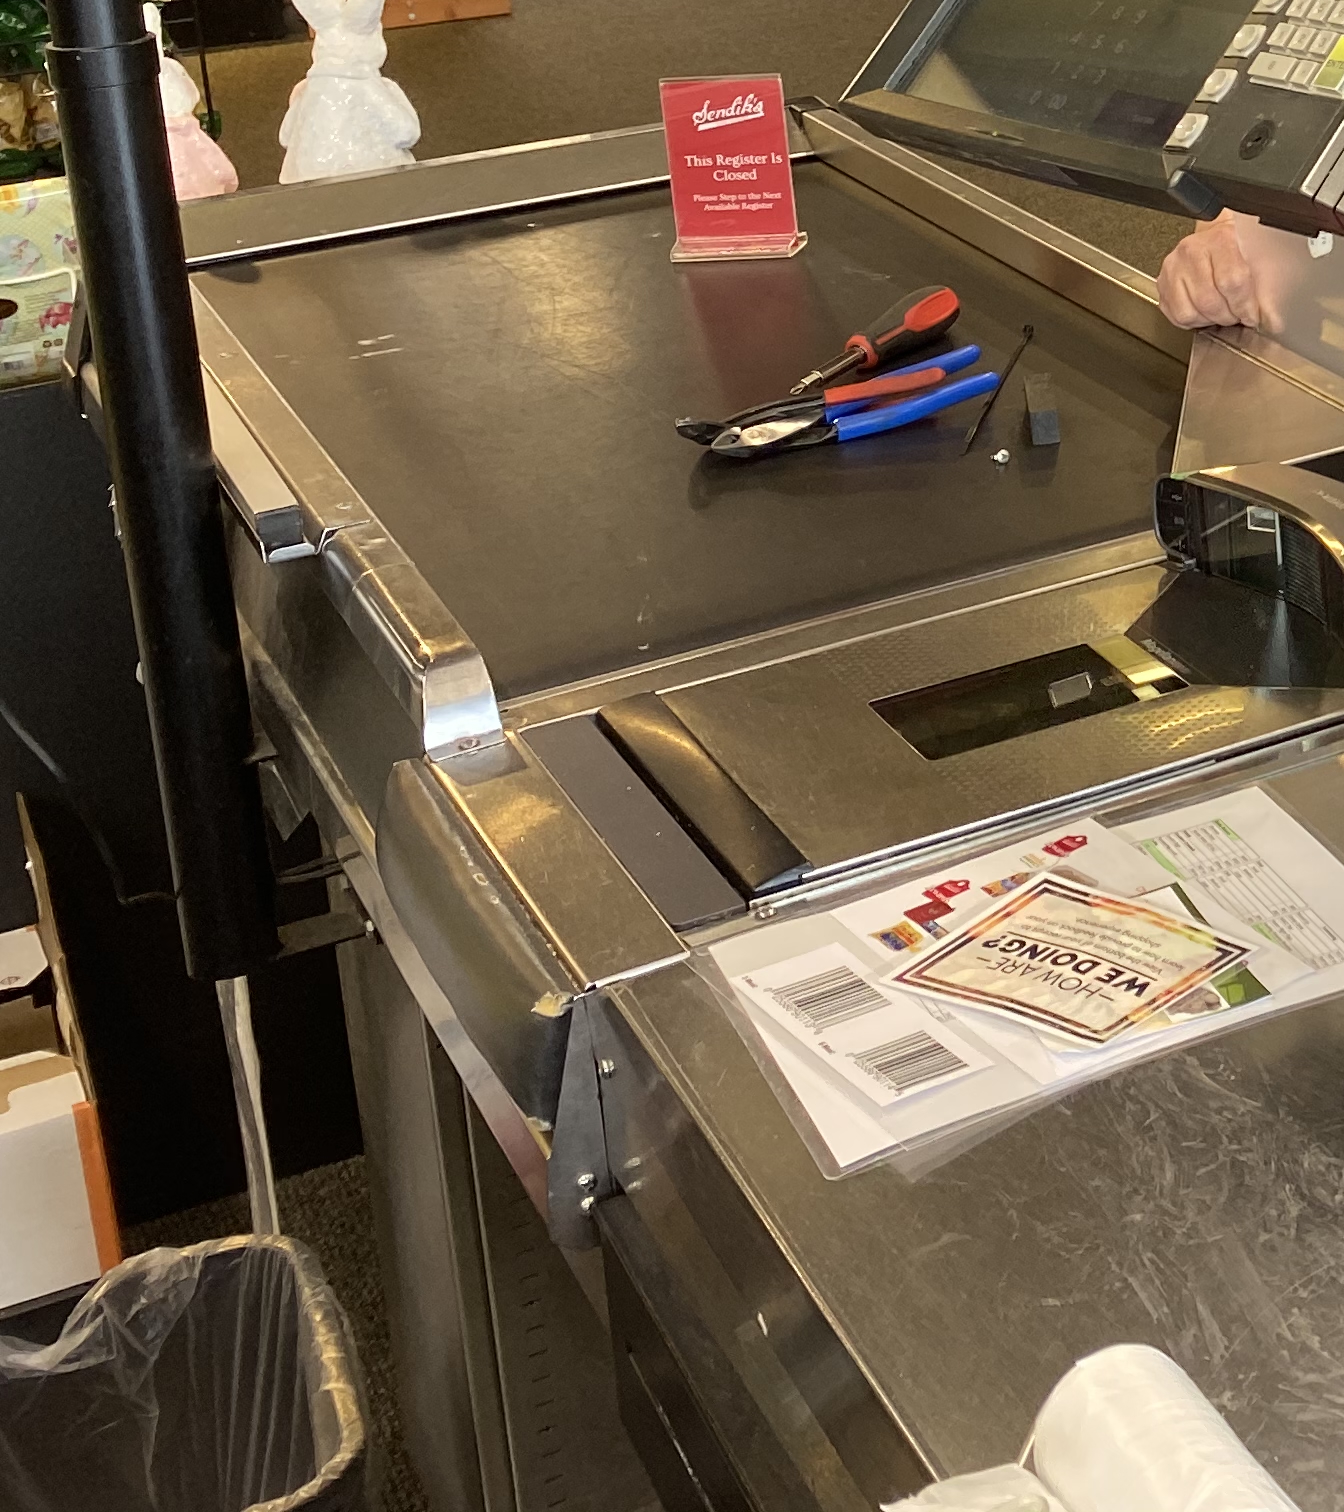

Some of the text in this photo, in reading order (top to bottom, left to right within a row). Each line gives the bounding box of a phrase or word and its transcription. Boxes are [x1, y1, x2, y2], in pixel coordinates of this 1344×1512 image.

[692, 93, 764, 131] Sendik's
[684, 152, 783, 168] This Register Is
[713, 168, 757, 182] Closed
[693, 194, 718, 202] Please
[719, 193, 737, 202] Step
[762, 192, 782, 200] Next
[704, 202, 774, 211] Available Register
[982, 935, 1151, 997] WE DOING?
[986, 957, 1099, 999] HOW ARE
